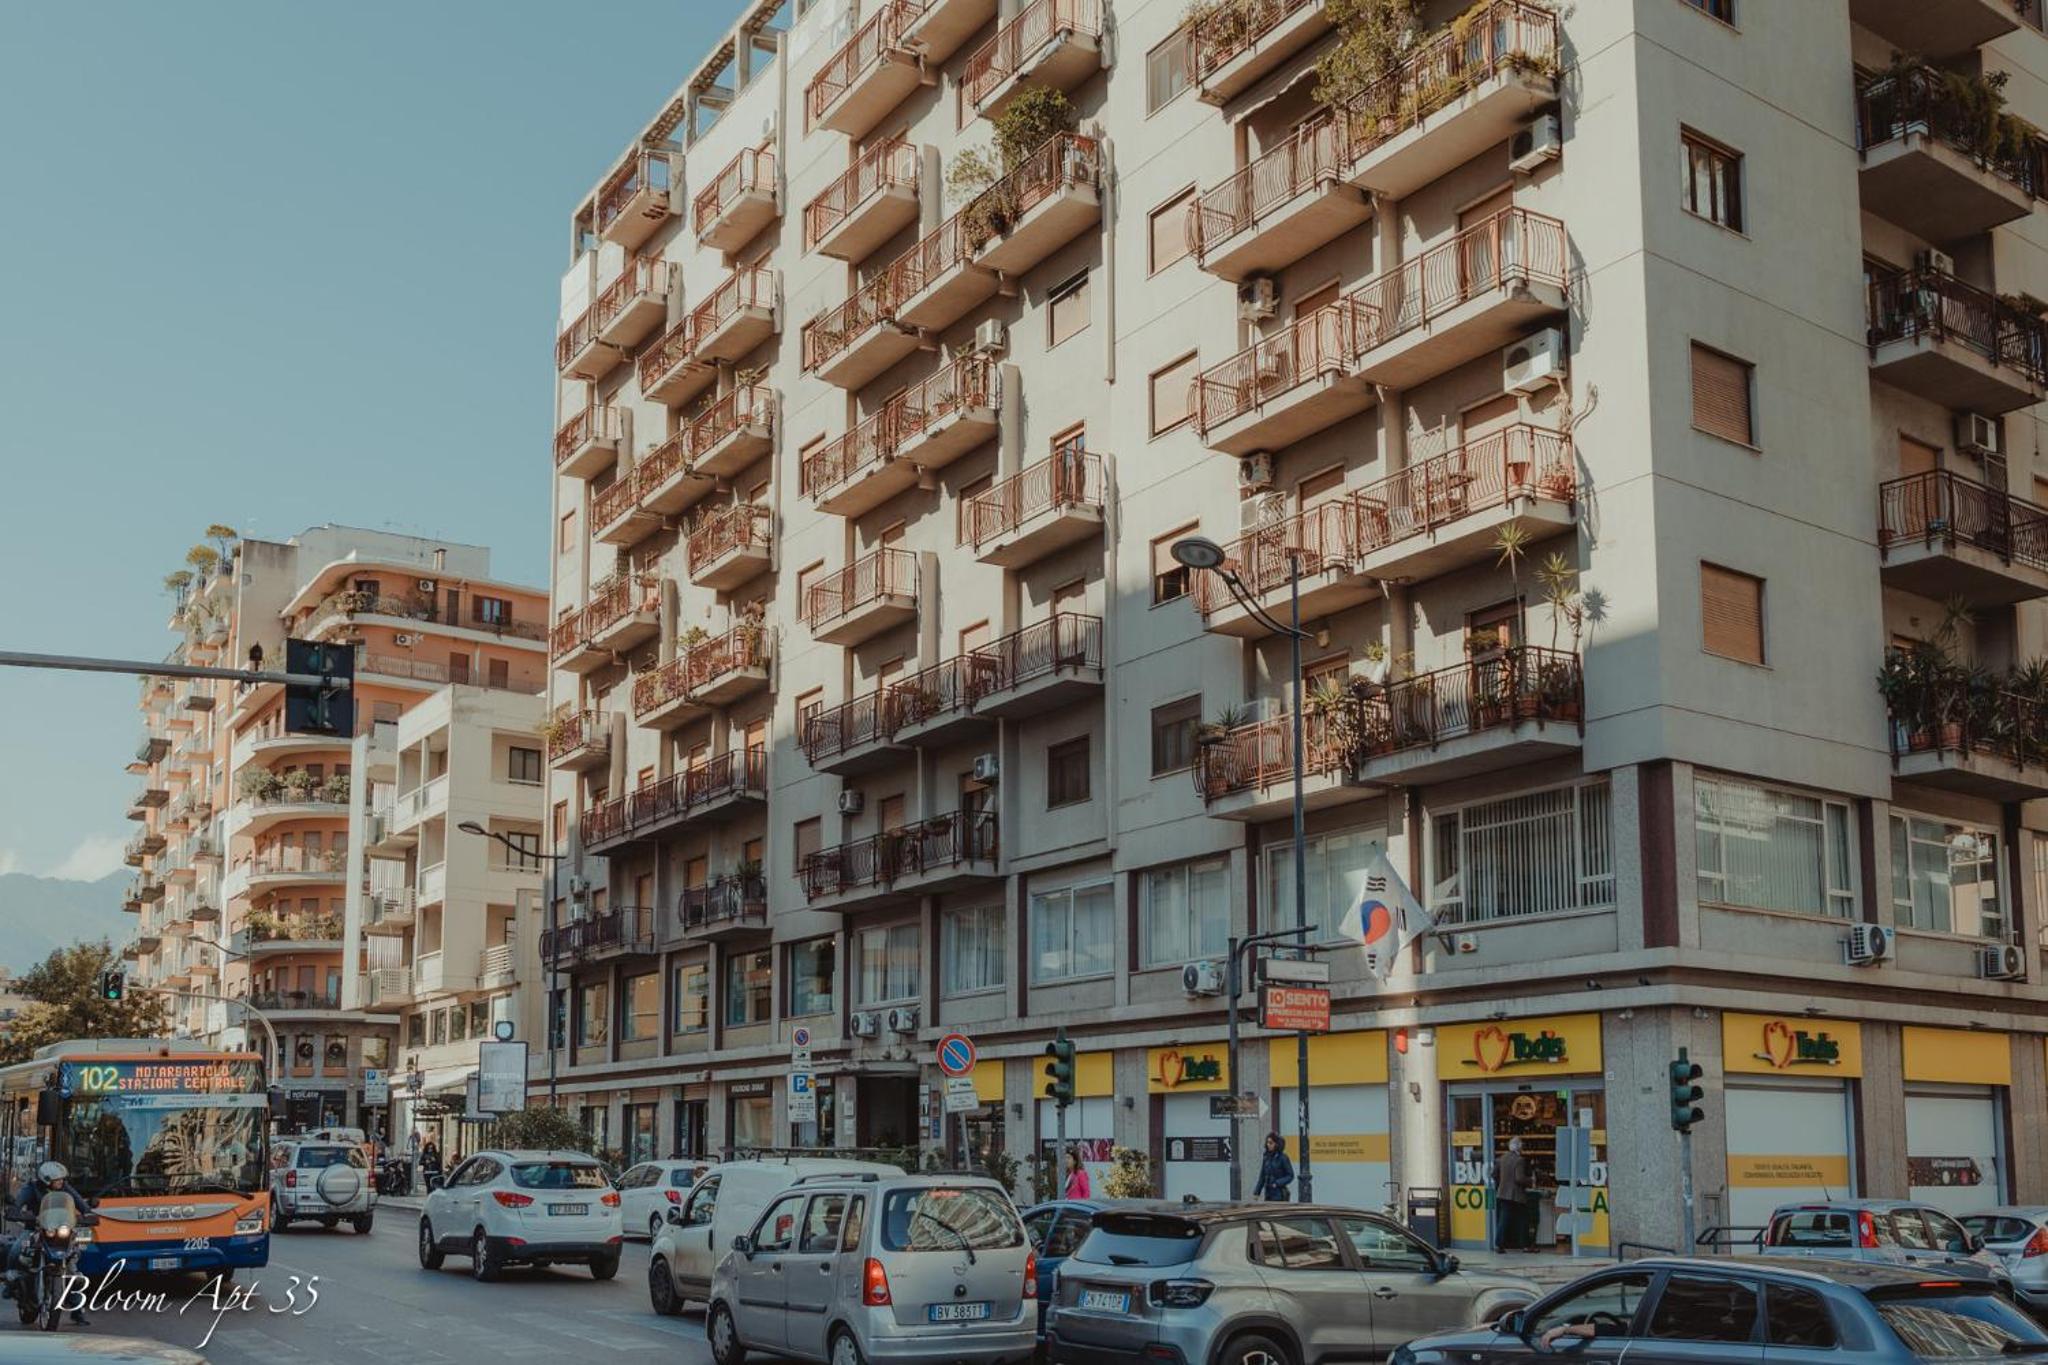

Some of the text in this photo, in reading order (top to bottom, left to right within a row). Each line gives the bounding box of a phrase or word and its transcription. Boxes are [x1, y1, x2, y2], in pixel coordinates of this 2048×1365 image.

[1269, 991, 1328, 1007] IO SENTO
[1509, 1030, 1566, 1059] Todis
[1795, 1031, 1839, 1059] Todis
[136, 1065, 230, 1077] NOTARBARTOLO
[1183, 1054, 1220, 1078] Todis
[79, 1067, 120, 1090] 102
[119, 1076, 246, 1090] STAZIONE CENTRALE
[137, 1205, 195, 1219] IVECO
[183, 1237, 210, 1250] 2205
